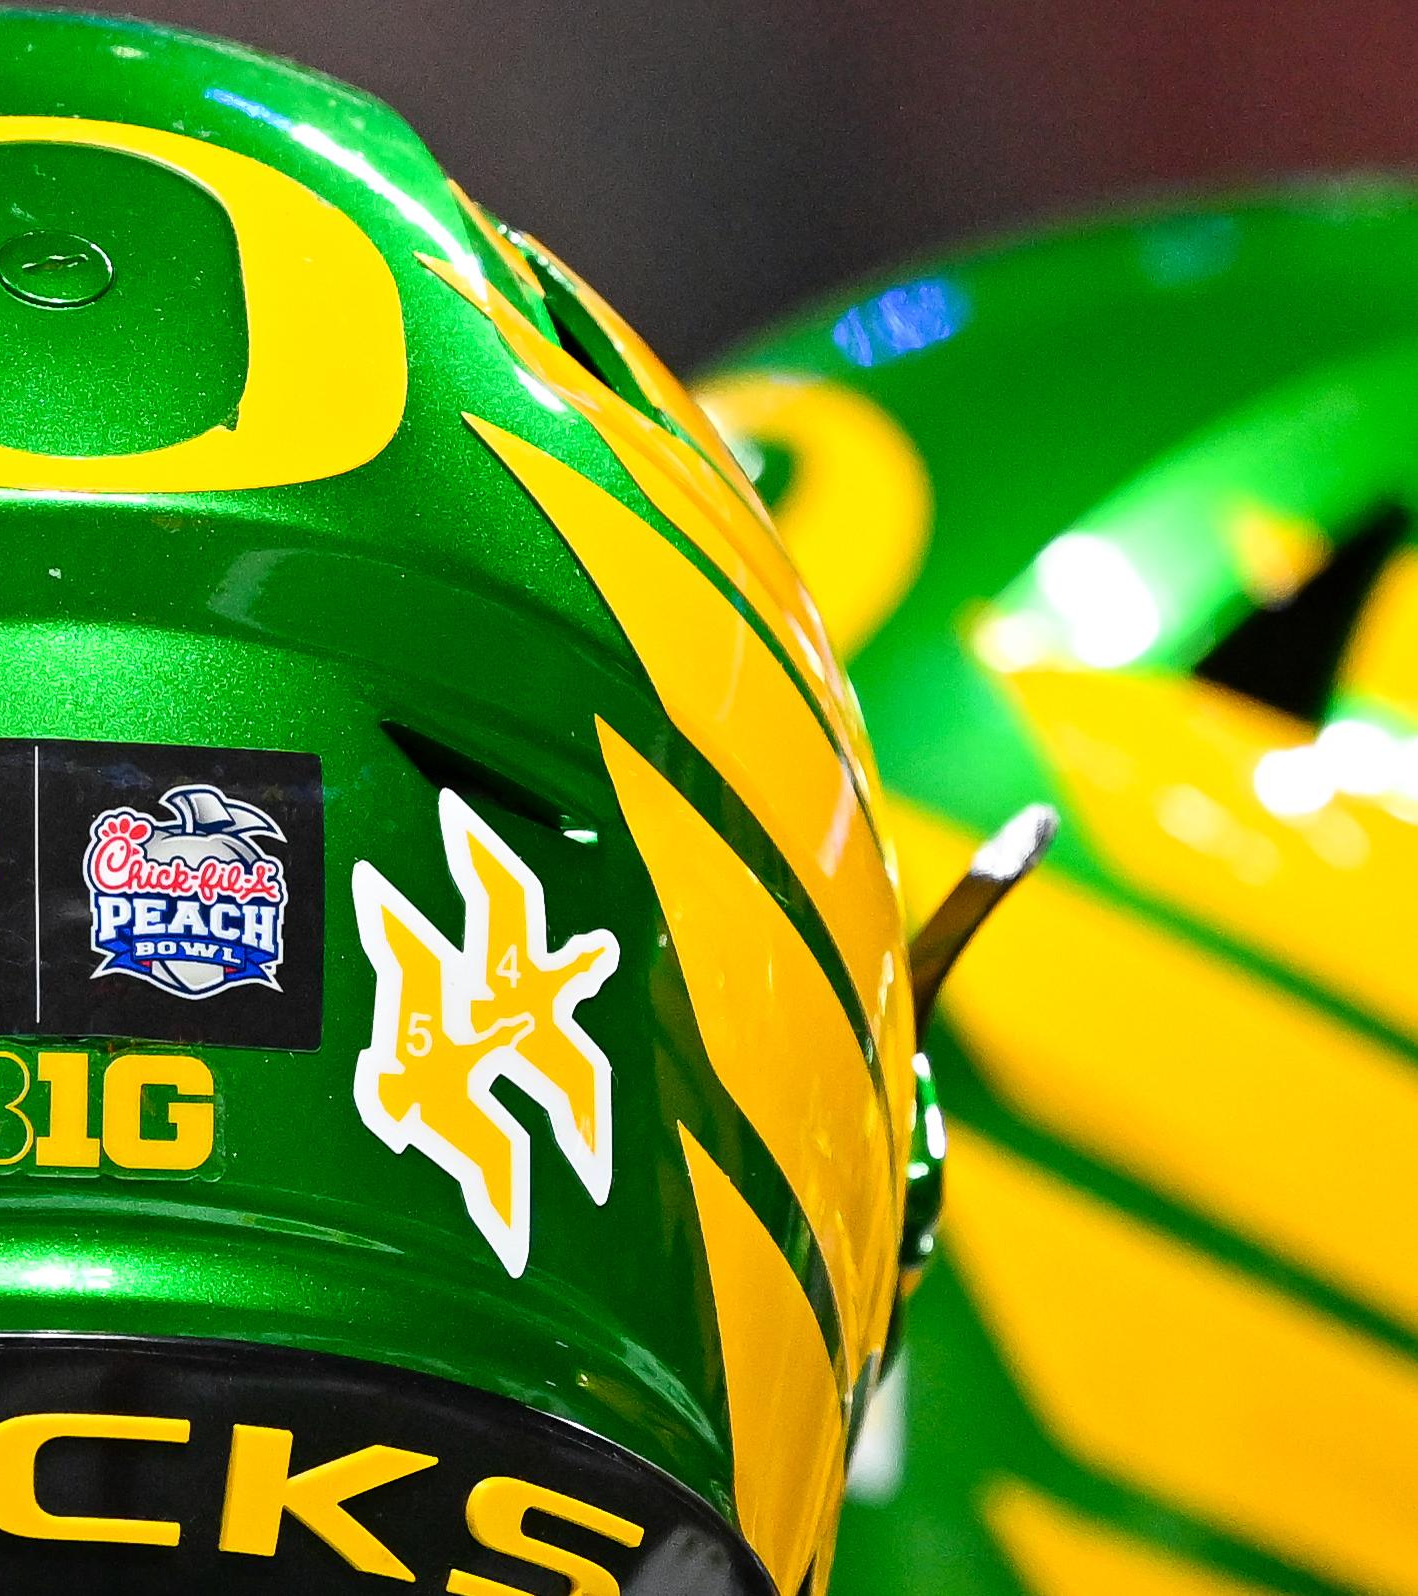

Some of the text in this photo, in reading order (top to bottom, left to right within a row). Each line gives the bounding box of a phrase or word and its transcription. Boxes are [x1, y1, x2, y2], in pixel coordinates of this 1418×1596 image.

[95, 834, 277, 902] Chick-fil-A
[98, 896, 277, 953] PEACH
[135, 941, 241, 964] BOWL
[495, 944, 521, 989] 4
[406, 1013, 433, 1057] 5
